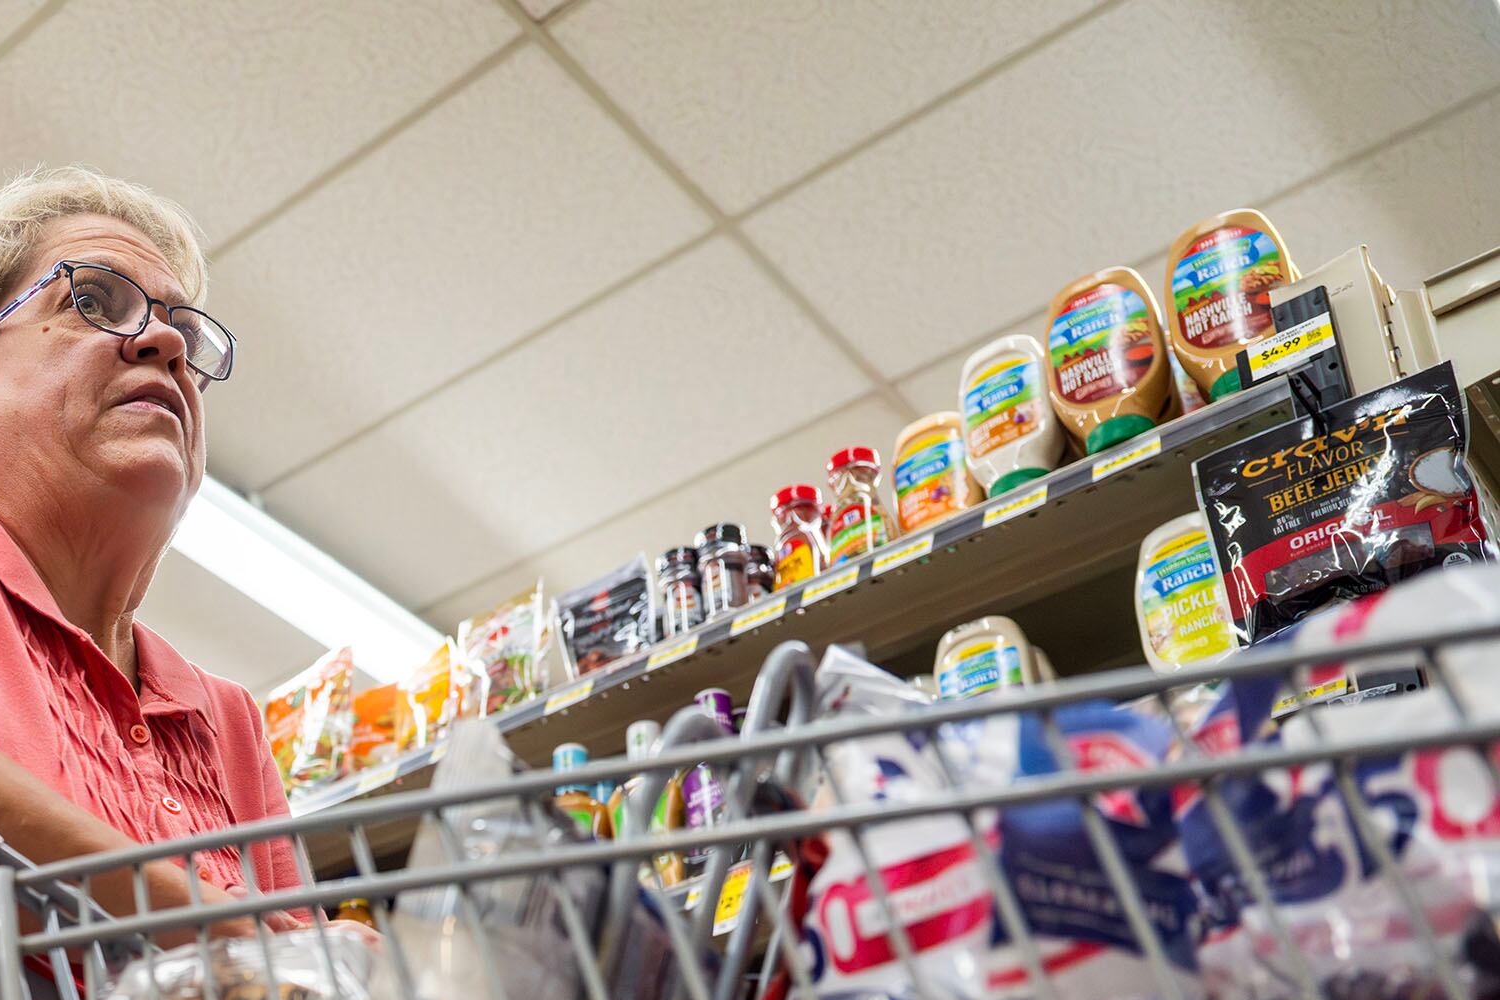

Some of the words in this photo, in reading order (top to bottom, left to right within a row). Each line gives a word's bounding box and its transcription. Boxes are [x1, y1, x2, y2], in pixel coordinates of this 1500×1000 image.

[1187, 316, 1209, 340] HOT
[1211, 302, 1253, 328] RANCH
[1261, 336, 1301, 361] $4.99
[1060, 350, 1113, 382] NASHVILL
[1083, 361, 1116, 384] RANC
[1285, 440, 1364, 481] FLAVOR
[1268, 480, 1315, 514] BEEF
[1161, 561, 1215, 593] Ranch
[1161, 584, 1222, 625] PICKLE
[1179, 613, 1218, 637] RANCH
